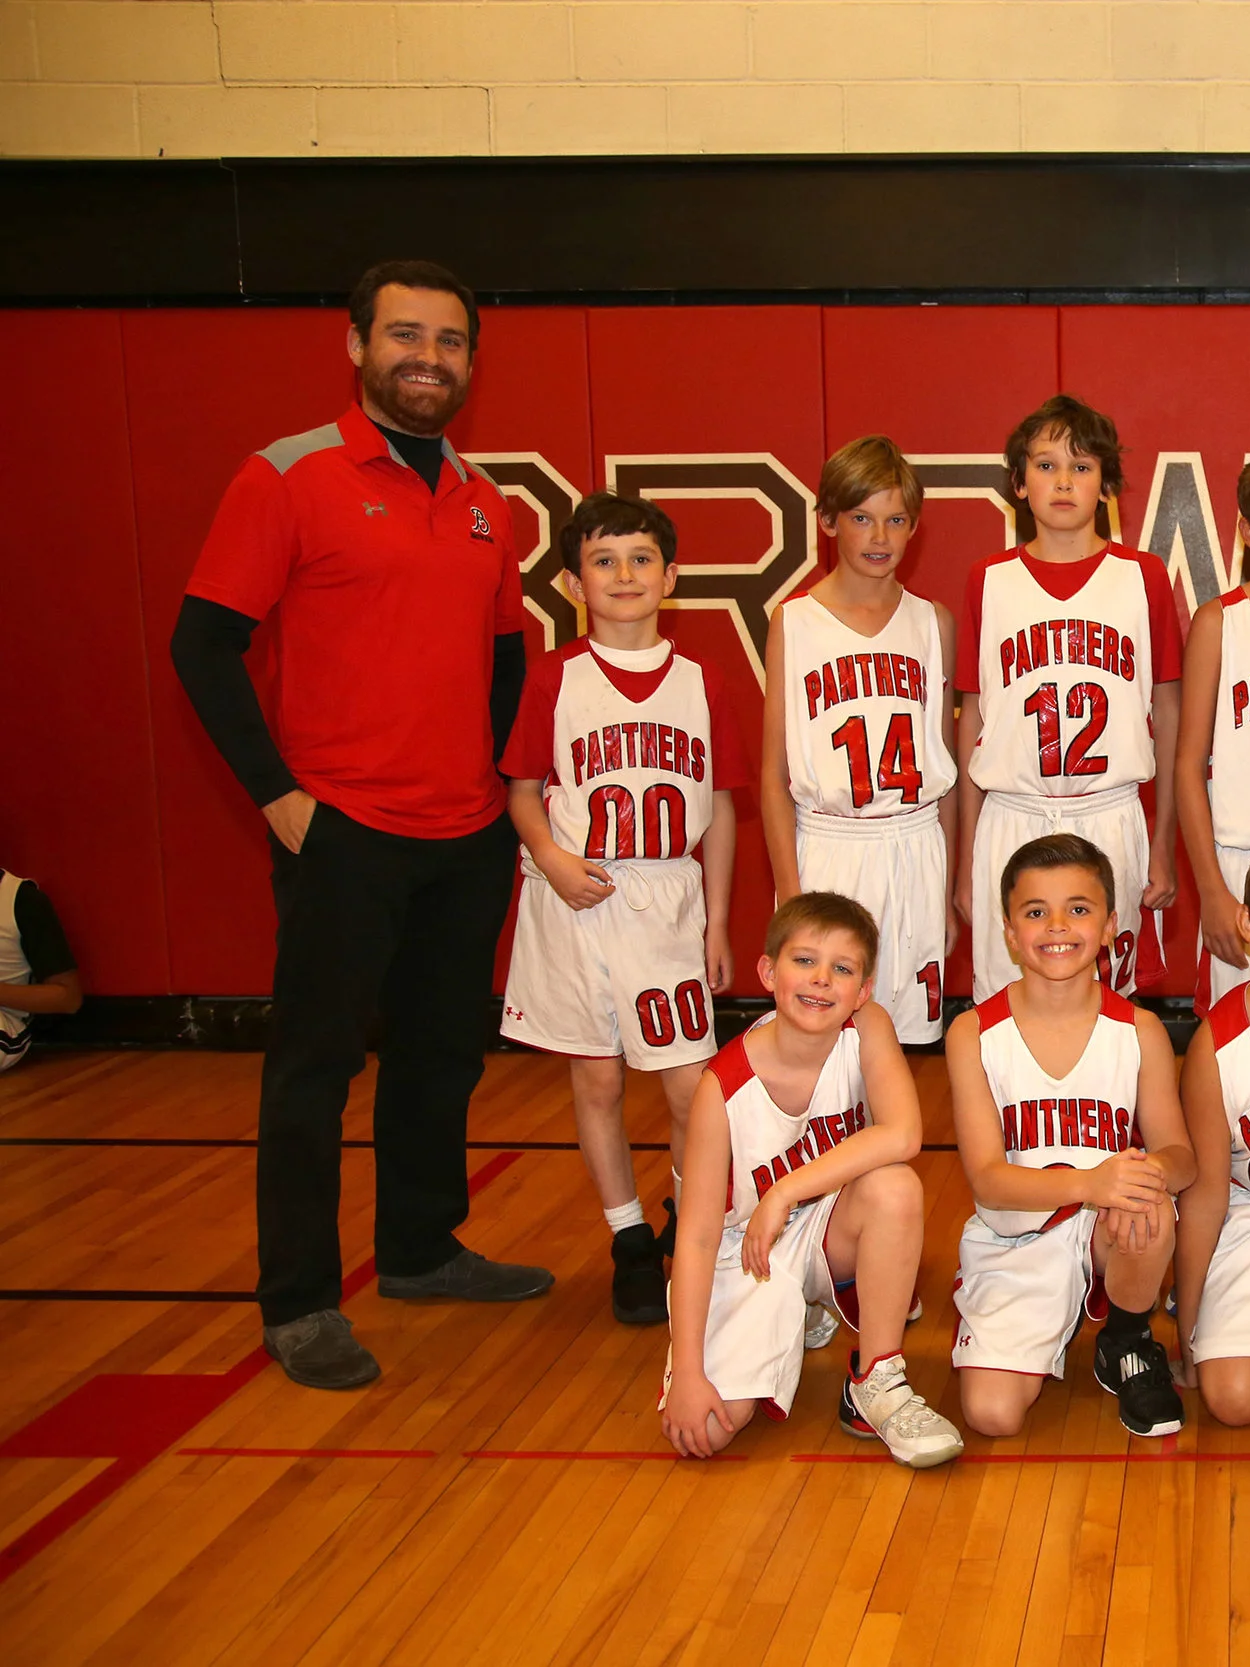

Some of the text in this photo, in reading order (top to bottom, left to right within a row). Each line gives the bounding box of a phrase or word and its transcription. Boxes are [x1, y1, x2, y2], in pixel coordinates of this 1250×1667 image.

[1000, 619, 1135, 688] PANTHERS
[571, 721, 706, 787] PANTHERS
[831, 713, 923, 809] 14
[1024, 682, 1108, 777] 12
[584, 783, 688, 860] 00
[635, 979, 709, 1047] 00
[916, 961, 942, 1022] 1
[1002, 1098, 1130, 1153] ANTHERS
[1120, 1352, 1151, 1383] NIK
